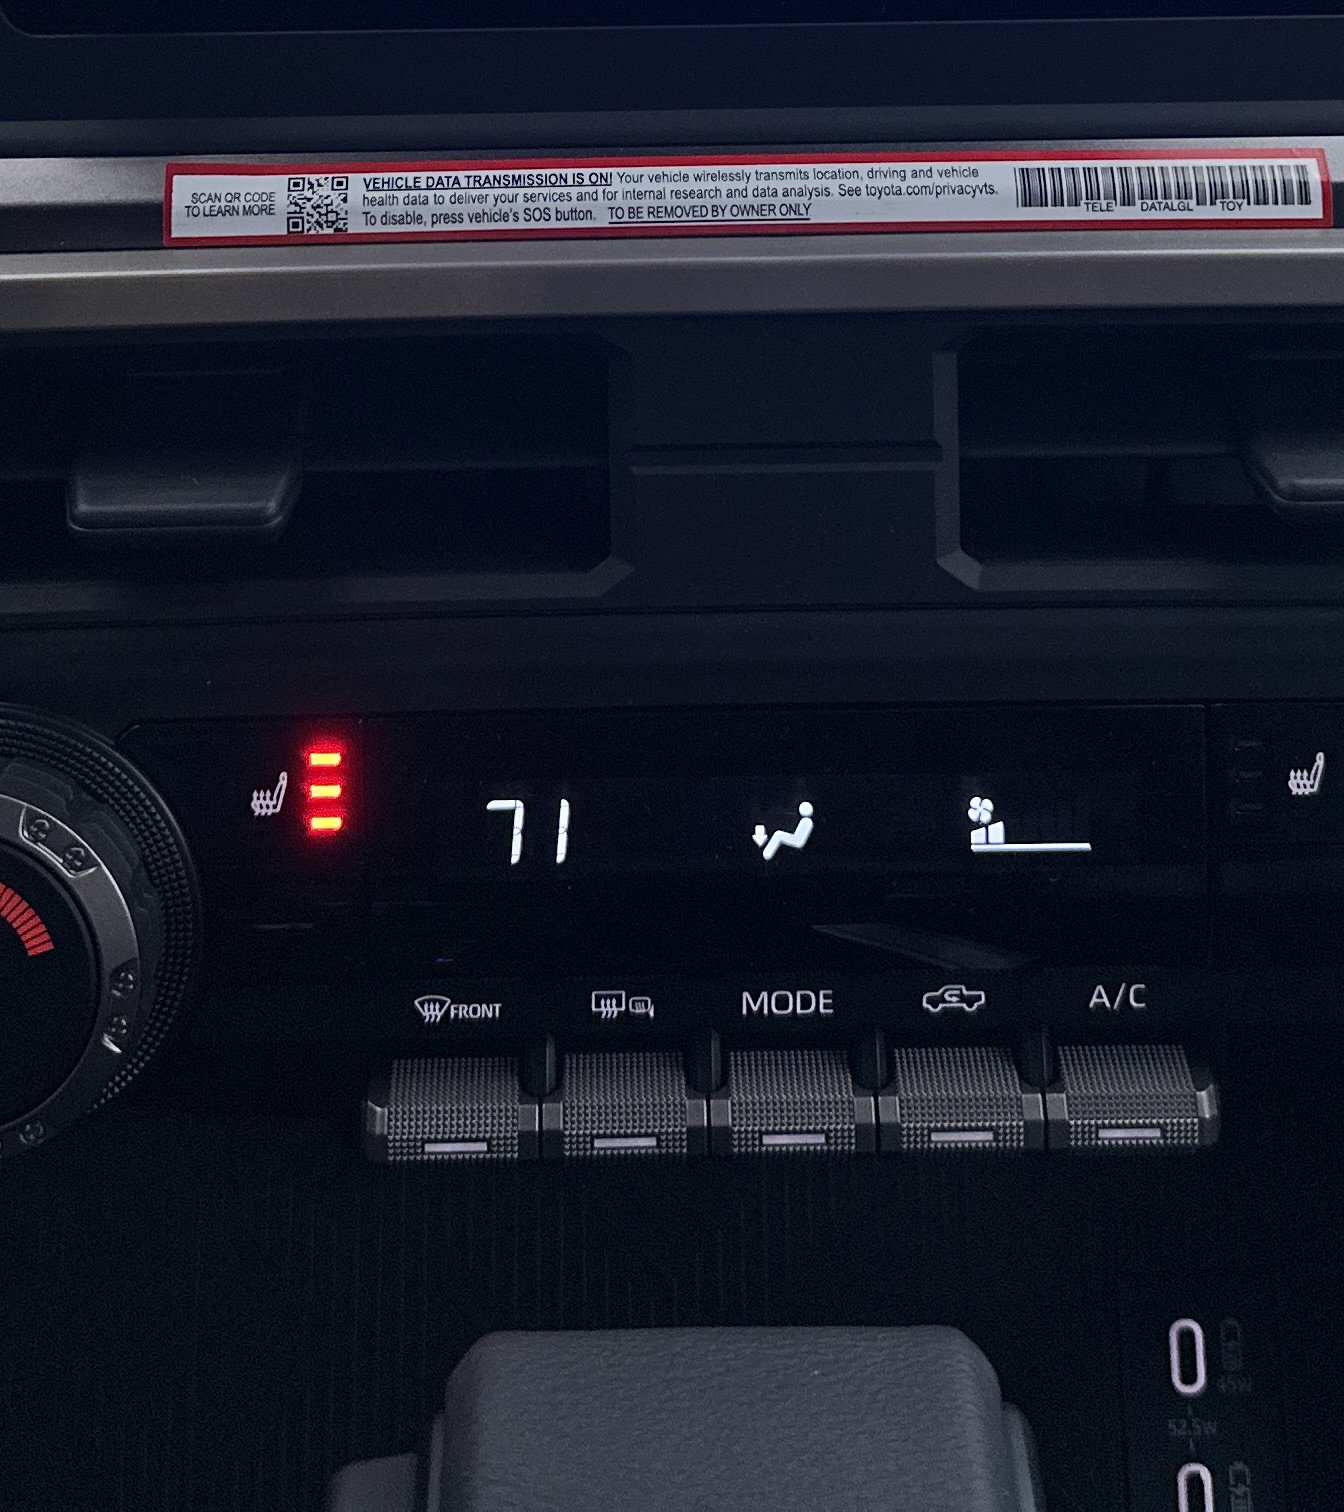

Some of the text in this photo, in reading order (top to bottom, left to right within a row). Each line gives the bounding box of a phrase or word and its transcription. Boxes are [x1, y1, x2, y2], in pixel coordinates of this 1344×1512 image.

[362, 166, 979, 190] VEHICLE DATA TRANSMISSION IS ON! Your vehicle wirelessly transmits location, driving and vehicle
[191, 191, 276, 204] SCAN QR CODE
[362, 194, 399, 207] health
[402, 193, 429, 206] data
[434, 194, 445, 205] to
[449, 192, 489, 205] deliver
[493, 192, 519, 207] your
[523, 191, 573, 203] services
[576, 189, 599, 202] and
[602, 188, 619, 201] for
[622, 187, 666, 201] internal
[669, 186, 722, 200] research
[725, 186, 748, 199] and
[751, 185, 778, 198] data
[781, 185, 834, 201] analysis.
[838, 184, 862, 197] See
[1084, 200, 1244, 212] TELE DATALGL TOY
[185, 204, 276, 218] TO LEARN MORE
[362, 202, 812, 228] To disable, press vehicle's SOS button. TO BE REMOVED BY OWNER ONLY
[486, 798, 570, 865] 71
[742, 990, 834, 1015] MODE
[1089, 983, 1147, 1010] A/C
[450, 1003, 502, 1019] FRONT
